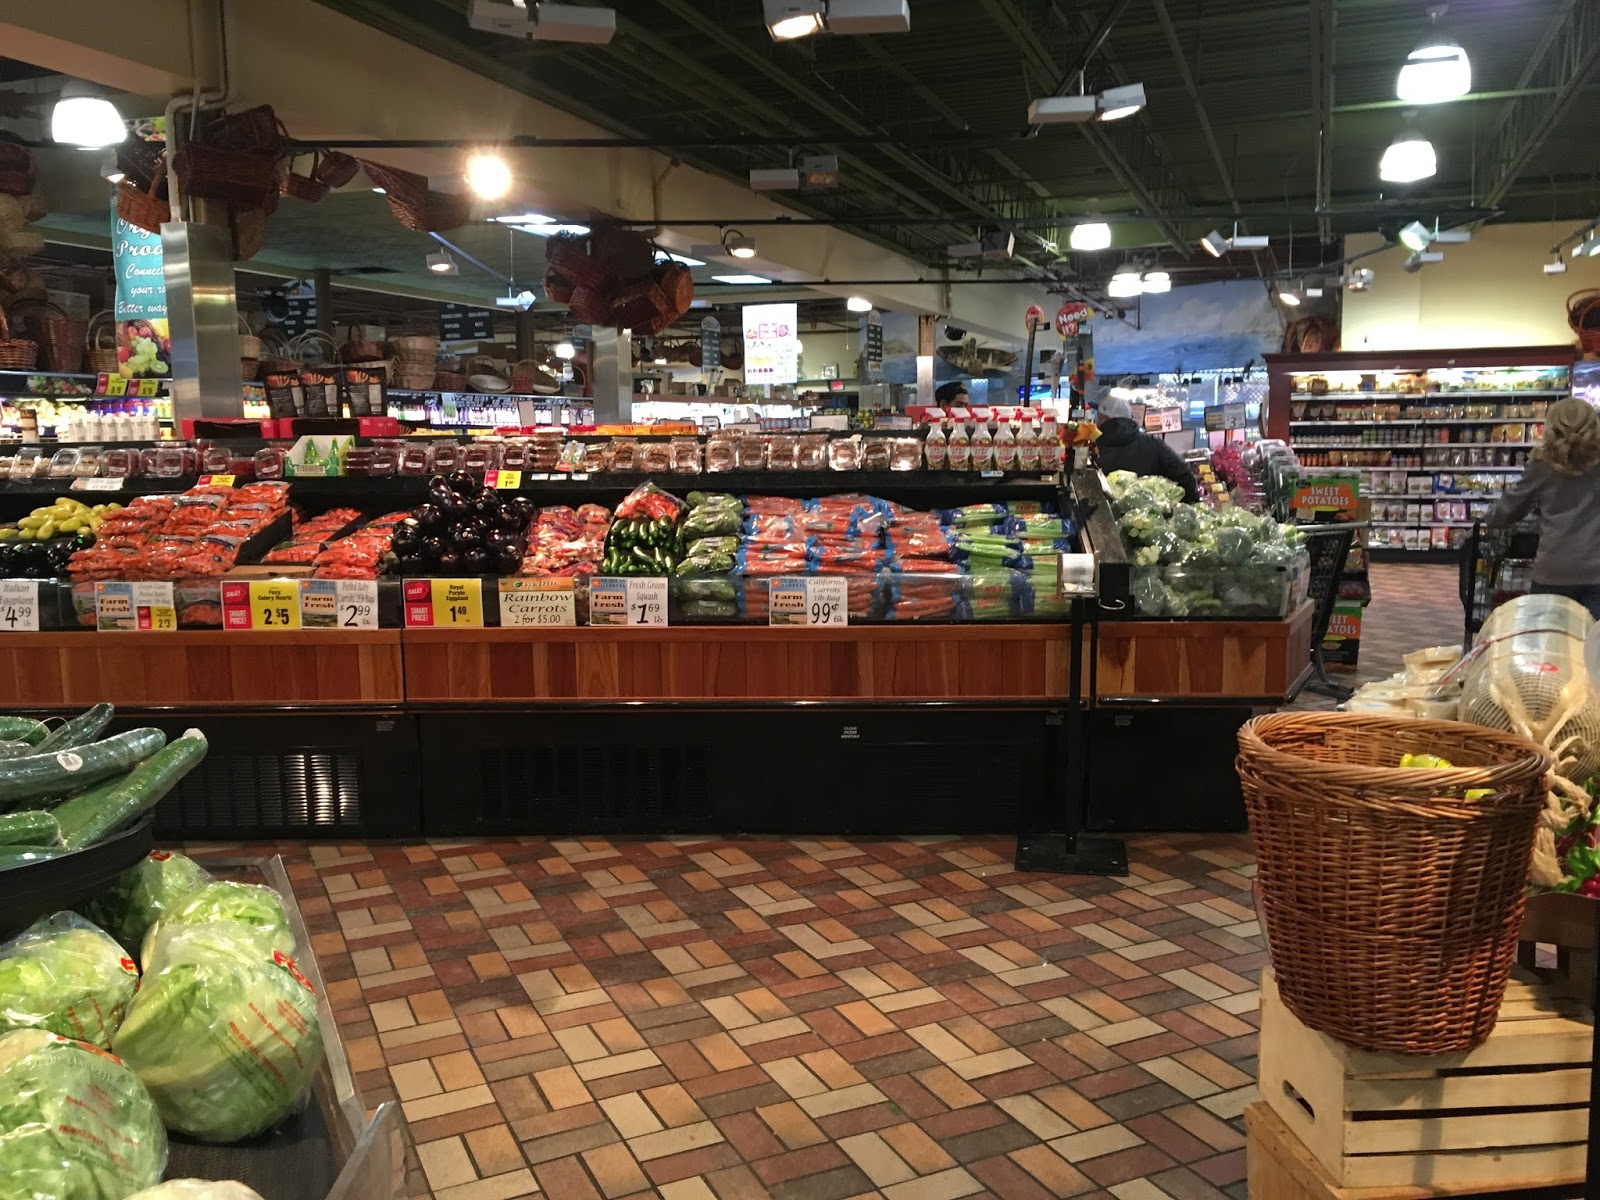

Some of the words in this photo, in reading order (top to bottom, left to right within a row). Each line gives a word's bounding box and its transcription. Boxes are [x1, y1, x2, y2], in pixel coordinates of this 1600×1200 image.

[130, 286, 154, 297] your
[118, 301, 144, 314] Better
[1059, 307, 1088, 324] Need
[1311, 486, 1340, 496] SWEET
[1301, 495, 1349, 505] POTATOES
[629, 580, 646, 589] Fresh
[647, 580, 666, 589] Green
[808, 578, 845, 586] California
[3, 583, 30, 592] Italian
[503, 592, 572, 602] Rainbow
[636, 591, 658, 602] Squash
[826, 594, 841, 602] Bag
[228, 609, 247, 618] SMART
[508, 604, 568, 613] Carrots
[229, 617, 247, 625] PRICE!
[263, 608, 273, 625] 2
[514, 615, 520, 624] 2
[522, 613, 536, 625] for
[537, 614, 561, 624] $5.00
